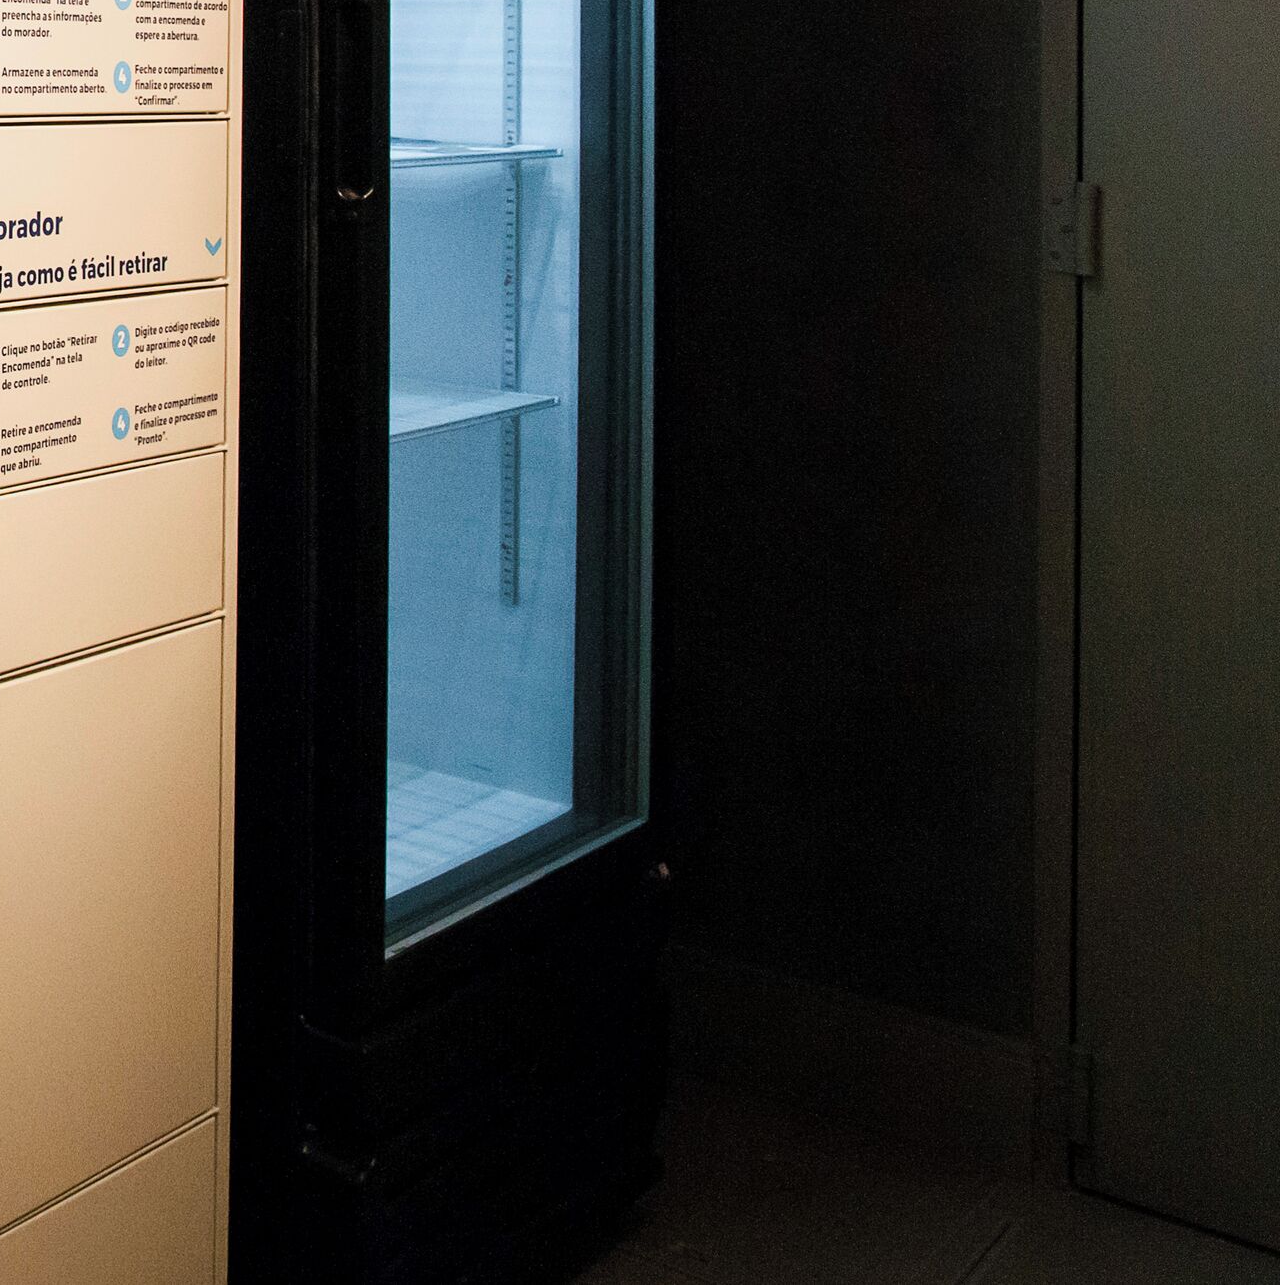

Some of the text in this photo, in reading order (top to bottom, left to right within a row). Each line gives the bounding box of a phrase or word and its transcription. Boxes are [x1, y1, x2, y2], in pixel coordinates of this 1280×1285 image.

[193, 0, 202, 10] de
[203, 1, 228, 11] acordo
[1, 10, 102, 25] preencha as informações
[135, 15, 206, 26] com a encomenda e
[1, 26, 12, 37] do
[135, 31, 160, 42] espere
[161, 32, 166, 40] a
[1, 67, 99, 77] Armazene a encomenda
[118, 67, 127, 85] 4
[135, 64, 224, 76] Feche o compartimento e
[1, 85, 12, 94] no
[13, 82, 77, 96] compartimento
[135, 80, 213, 92] finalize o processo em
[17, 266, 64, 287] como
[68, 259, 77, 281] é
[81, 255, 115, 280] fácil
[119, 251, 168, 276] retirar
[135, 317, 220, 339] Digite o código recebido
[117, 330, 125, 349] 2
[135, 333, 216, 354] ou aproxime o QR code
[1, 344, 28, 358] Clique
[30, 344, 41, 353] no
[42, 337, 66, 351] botão
[55, 356, 66, 365] na
[67, 352, 83, 363] tela
[135, 359, 145, 369] do
[1, 379, 12, 390] de
[134, 392, 219, 415] Feche o compartimento
[117, 414, 126, 432] 4
[134, 408, 218, 431] e finalize o processo em
[1, 415, 82, 439] Retire a encomenda
[1, 434, 77, 456] no compartimento
[0, 461, 17, 475] que
